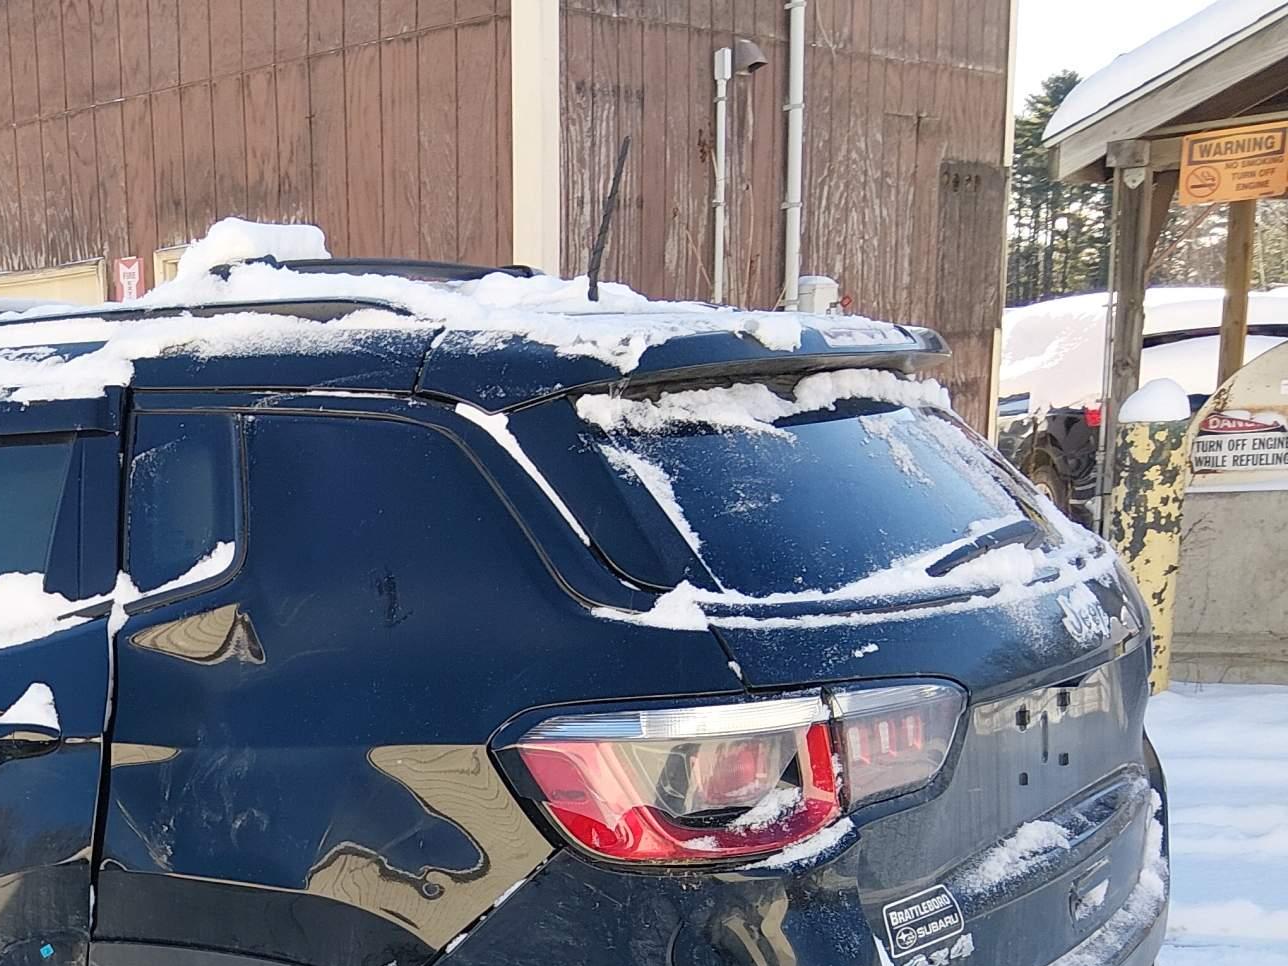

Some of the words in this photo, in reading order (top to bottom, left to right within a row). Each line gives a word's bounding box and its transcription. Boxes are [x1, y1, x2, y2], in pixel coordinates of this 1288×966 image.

[1198, 135, 1276, 159] WARNING
[1258, 167, 1276, 178] OFF
[1194, 439, 1223, 453] TURN
[1227, 438, 1249, 452] OFF
[1194, 454, 1228, 468] WHILE
[1232, 451, 1288, 467] REFUELING
[888, 893, 952, 927] BRATTLEBORO
[916, 912, 960, 939] SUBARU
